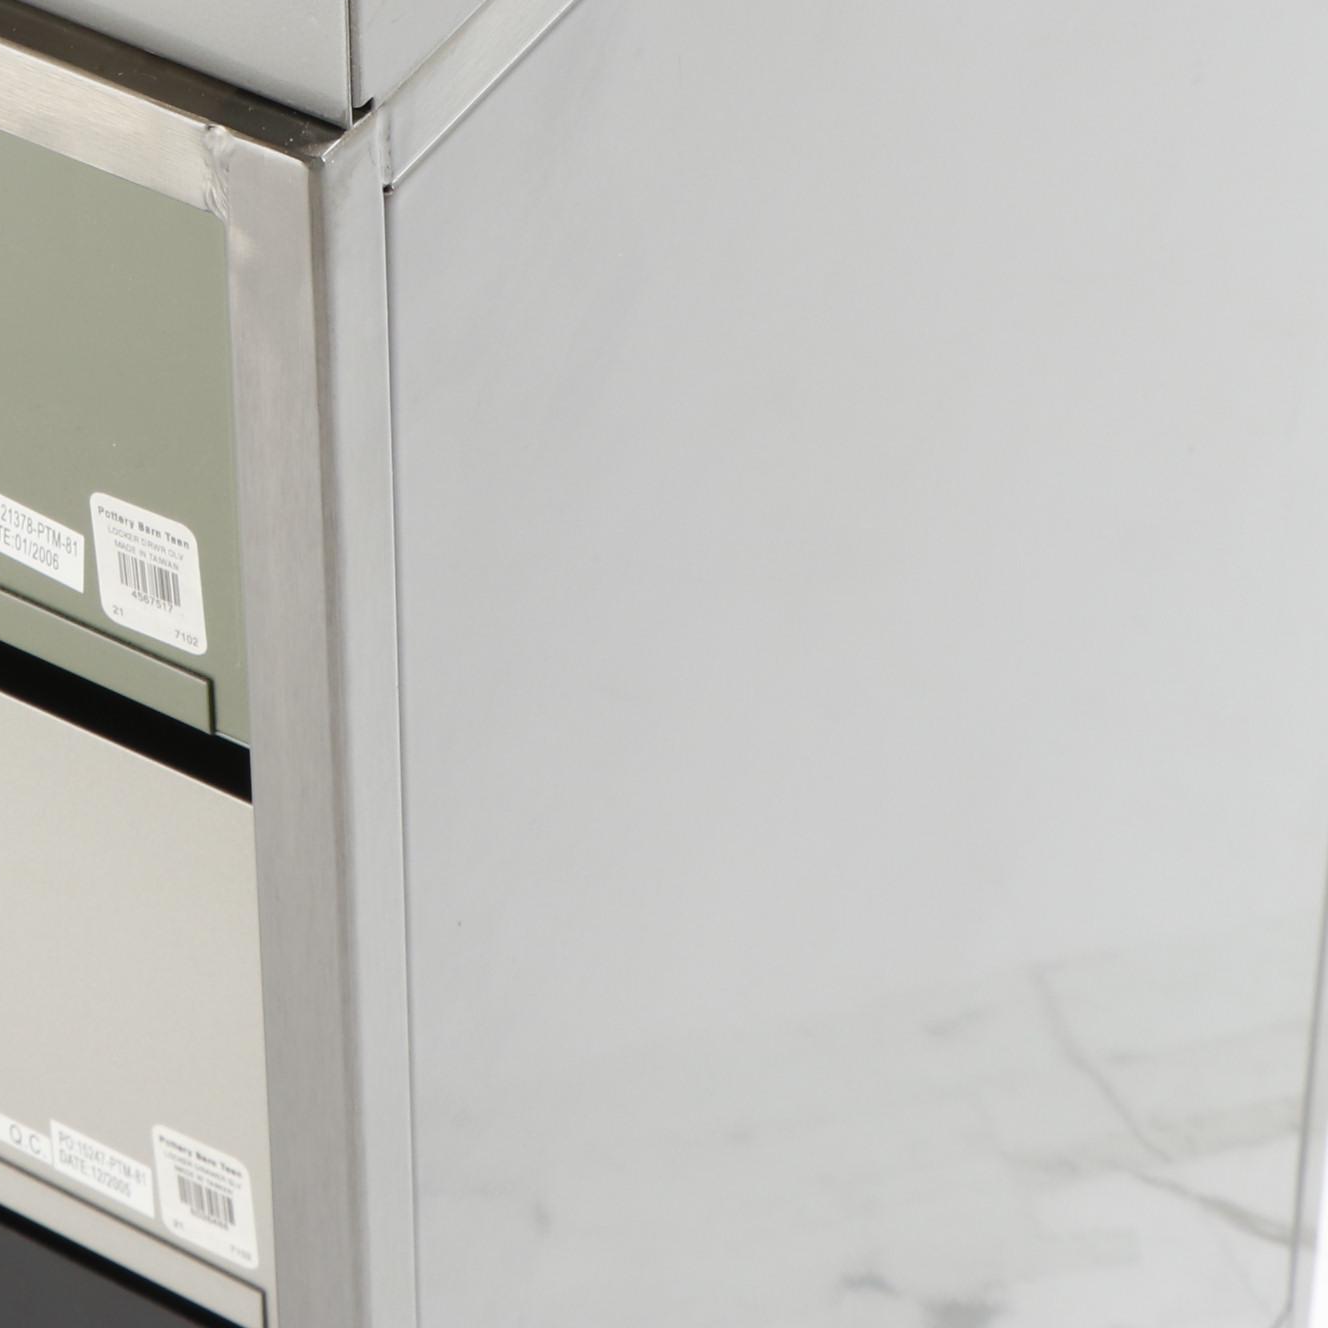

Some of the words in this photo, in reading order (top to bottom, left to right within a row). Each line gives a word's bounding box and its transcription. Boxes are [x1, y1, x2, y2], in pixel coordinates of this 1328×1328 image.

[97, 504, 135, 530] Pottery
[137, 520, 163, 540] Barn
[165, 531, 191, 550] Teen
[175, 629, 200, 648] 7102
